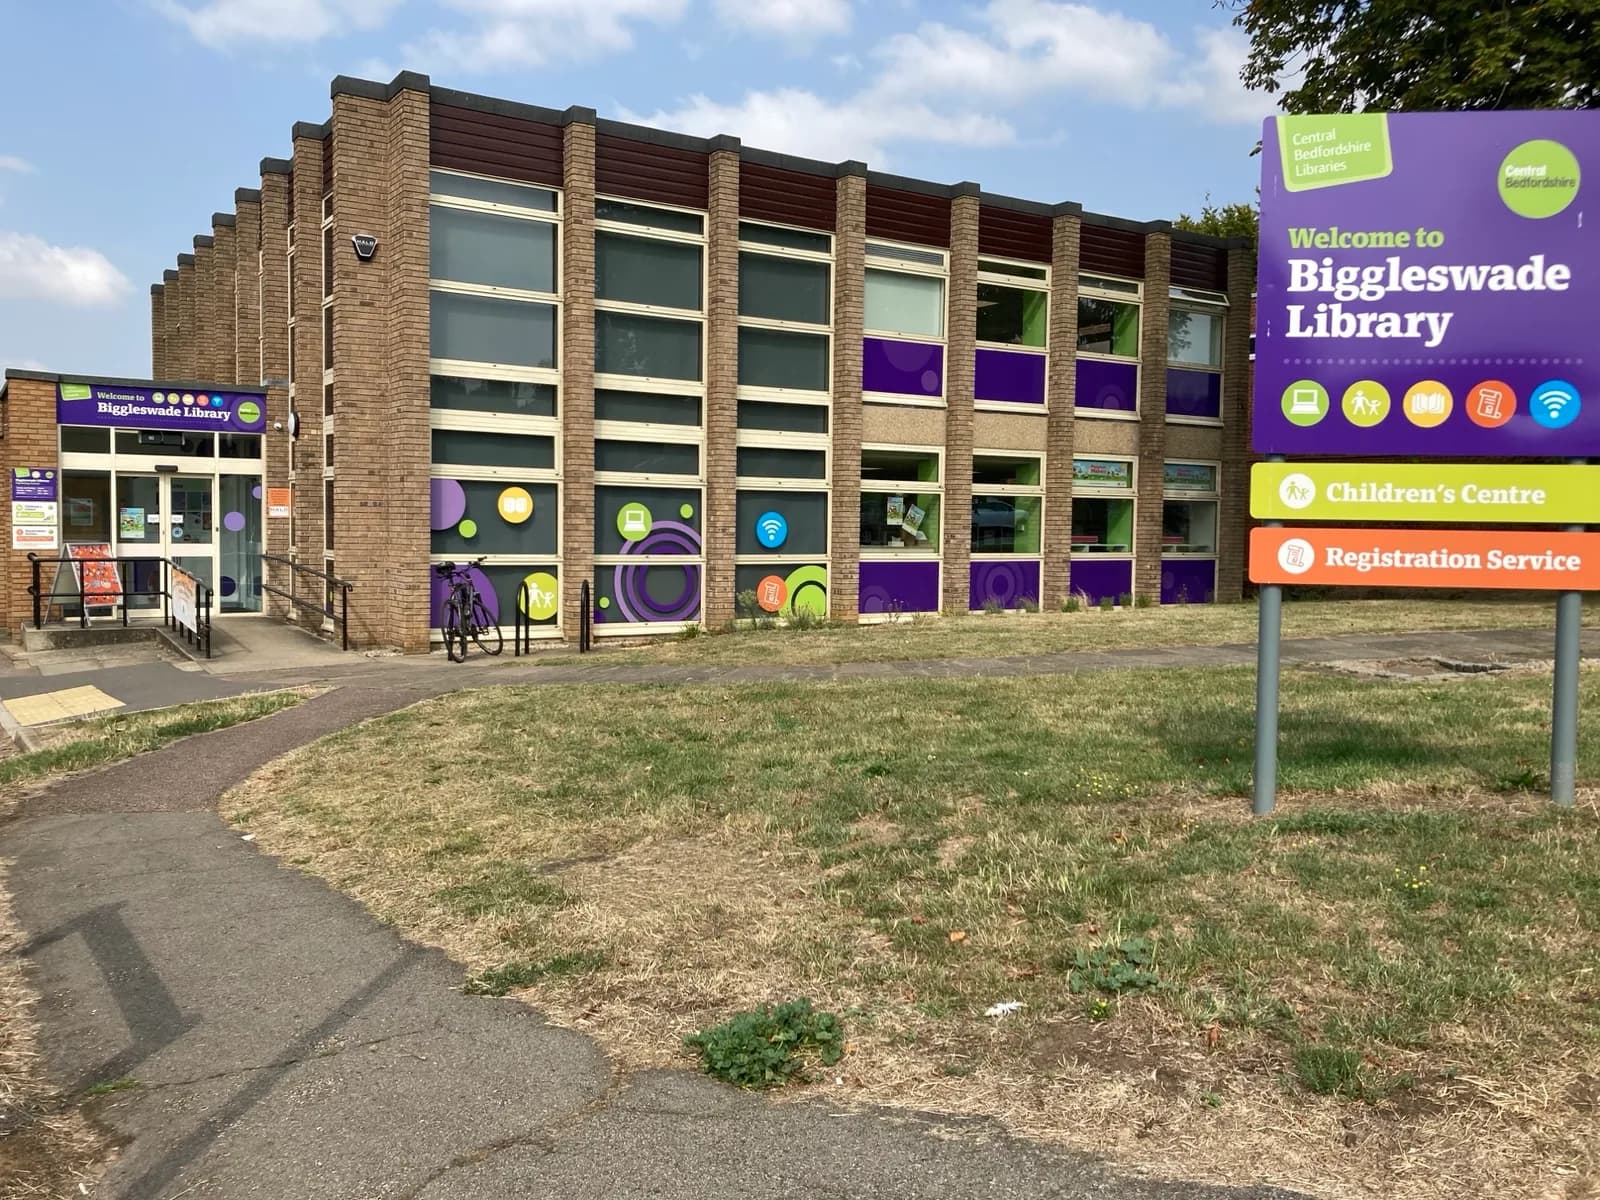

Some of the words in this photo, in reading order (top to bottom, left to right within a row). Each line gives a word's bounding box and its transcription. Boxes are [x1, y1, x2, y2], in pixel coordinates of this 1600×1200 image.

[1292, 128, 1336, 145] Central
[1294, 140, 1371, 160] Bedfordshire
[1295, 159, 1347, 177] Libraries
[1504, 164, 1547, 177] Central
[1504, 176, 1576, 188] Bedfordshire
[1288, 228, 1410, 249] Welcome
[1415, 227, 1445, 248] to
[1286, 254, 1571, 302] Biggleswade
[1285, 303, 1454, 348] Library
[96, 391, 135, 401] Welcome
[97, 402, 182, 417] Biggleswade
[183, 407, 231, 422] Library
[1325, 482, 1456, 504] Children’s
[1461, 484, 1546, 504] Centre
[1325, 546, 1481, 571] Registration
[1486, 549, 1581, 571] Service
